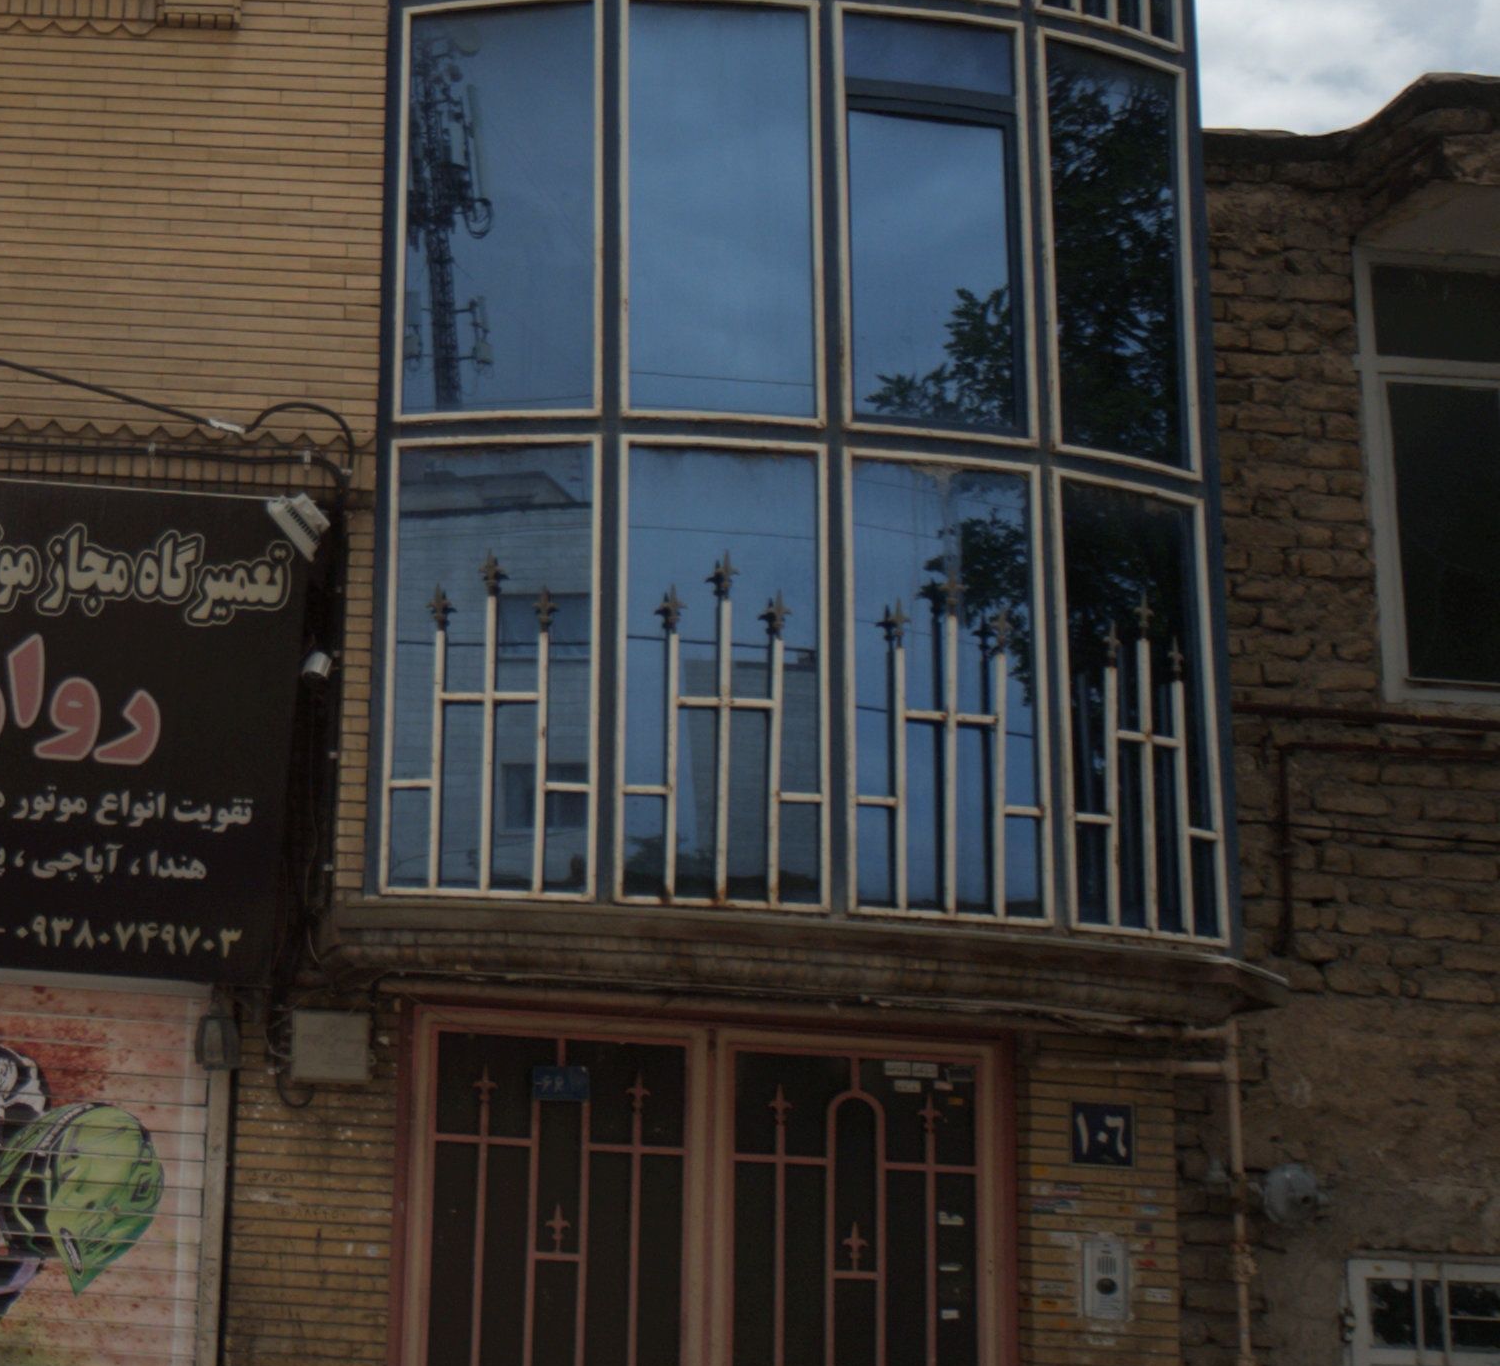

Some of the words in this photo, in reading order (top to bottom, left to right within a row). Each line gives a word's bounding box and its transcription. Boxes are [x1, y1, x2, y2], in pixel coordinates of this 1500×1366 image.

[40, 528, 132, 614] مجاز
[12, 786, 87, 822] موتور
[95, 790, 166, 827] انواع
[173, 797, 253, 832] تقویت
[31, 843, 123, 883] آپاچی
[149, 849, 208, 880] هندا
